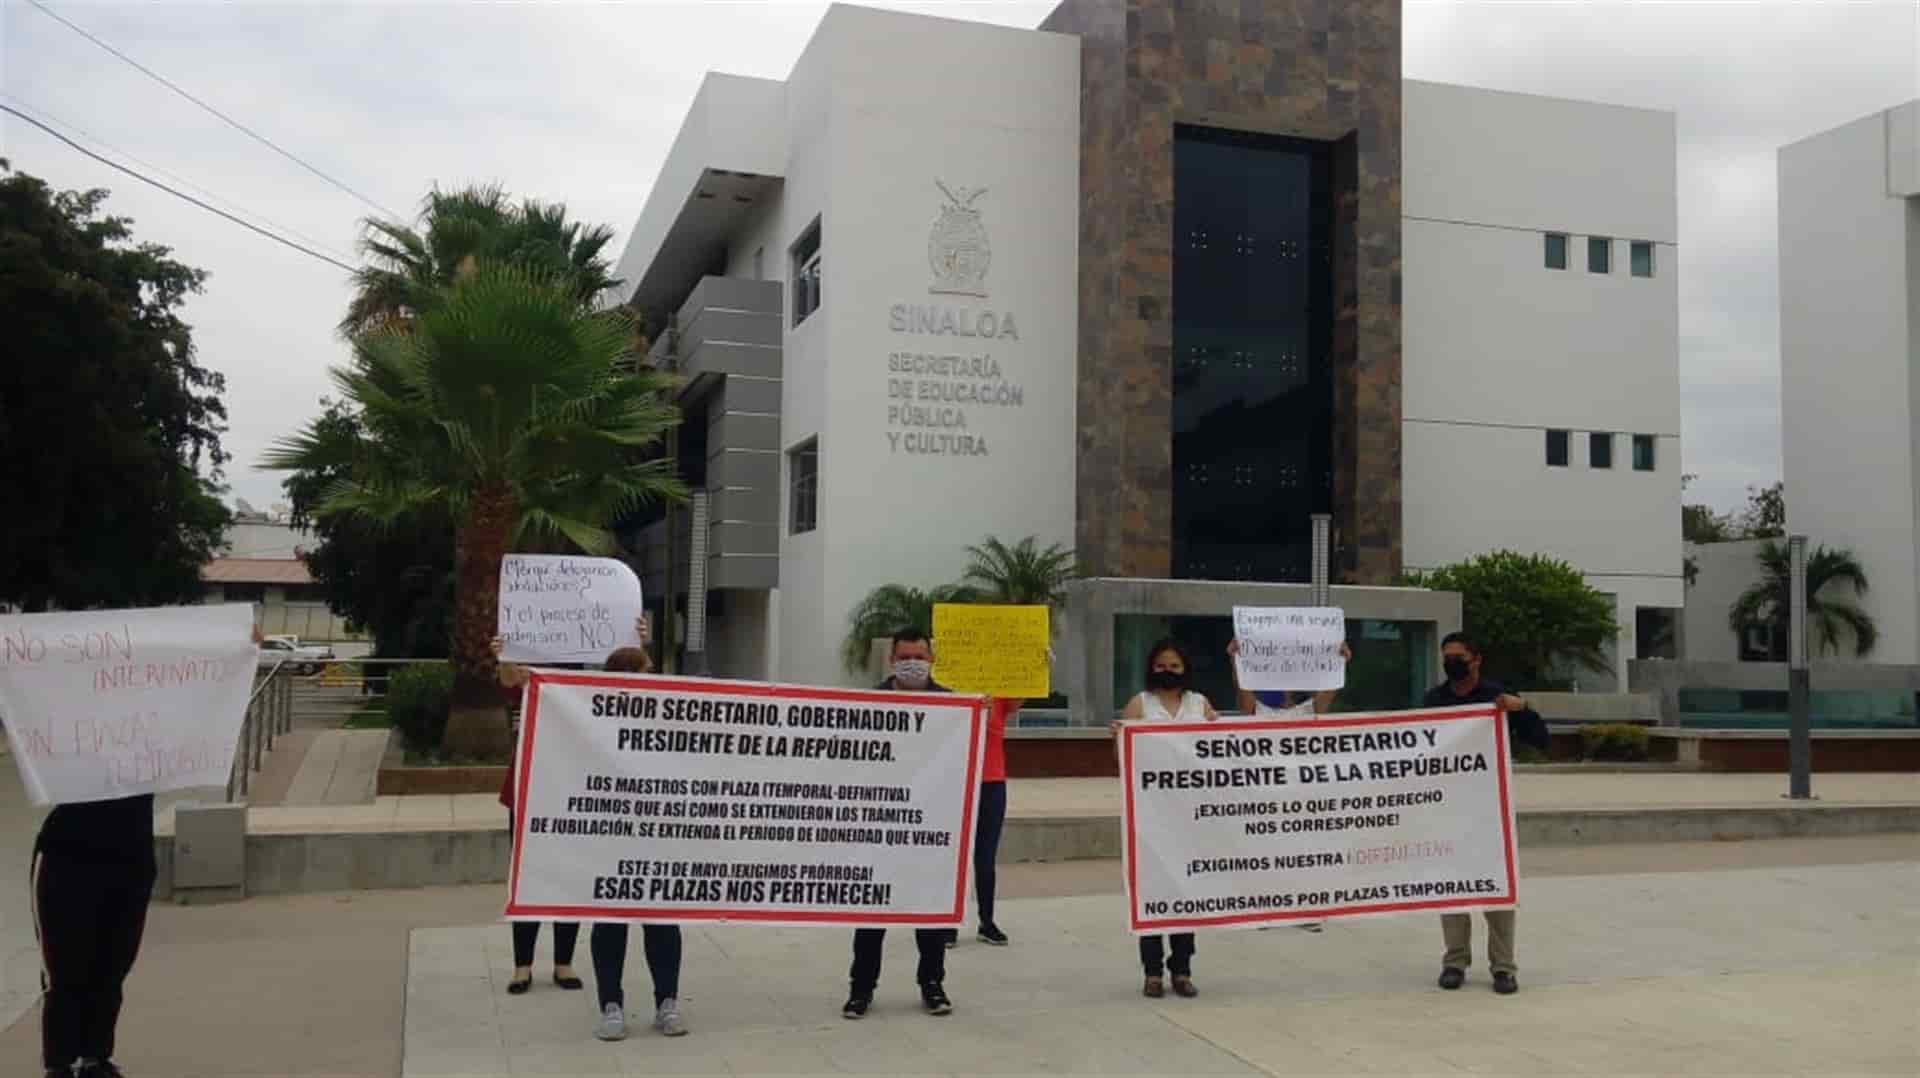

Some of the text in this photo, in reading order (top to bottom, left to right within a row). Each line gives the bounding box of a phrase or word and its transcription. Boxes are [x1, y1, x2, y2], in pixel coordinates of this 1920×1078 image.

[889, 304, 1019, 340] SINALOA
[888, 352, 1001, 377] SECRETARÍA
[888, 378, 1023, 406] DE EDUCACIÓN
[888, 401, 967, 428] PÚBLICA
[886, 431, 989, 456] Y CULTURA
[3, 623, 133, 664] NO SON
[580, 622, 616, 649] NO
[592, 692, 925, 732] SEÑOR SECRETARIO, GOBERNADOR Y
[618, 728, 896, 762] PRESIDENTE DE LA REPÚBLICA.
[1195, 729, 1437, 758] SEÑOR SECRETARIO Y
[1141, 753, 1488, 790] PRESIDENTE DE LA REPÚBLICA
[586, 776, 911, 803] LOS MAESTROS CON PLAZA (TEMPORAL-DEFINITIVA)
[568, 797, 924, 825] PEDIMOS QUE ASÍ COMO SE EXTENDIERON LOS TRÁMITES
[1195, 790, 1443, 820] ¡EXIGIMOS LO QUE POR DERECHO
[530, 817, 548, 833] DE
[638, 822, 655, 838] SE
[658, 823, 720, 840] EXTIENDA
[723, 825, 736, 841] EL
[739, 826, 795, 842] PERIODO
[798, 826, 814, 843] DE
[816, 827, 883, 845] IDONEIDAD
[886, 829, 909, 846] QUE
[912, 831, 951, 847] VENCE
[1245, 814, 1400, 836] NOS CORRESPONDE!
[618, 860, 650, 876] ESTE
[652, 861, 669, 876] 31
[672, 861, 688, 877] DE
[800, 863, 873, 882] PRÓRROGA!
[1187, 857, 1270, 876] ¡EXIGIMOS
[1275, 852, 1343, 869] NUESTRA
[594, 876, 891, 905] ESAS PLAZAS NOS PERTENECEN!
[1145, 879, 1500, 914] NO CONCURSAMOS POR PLAZAS TEMPORALES.
